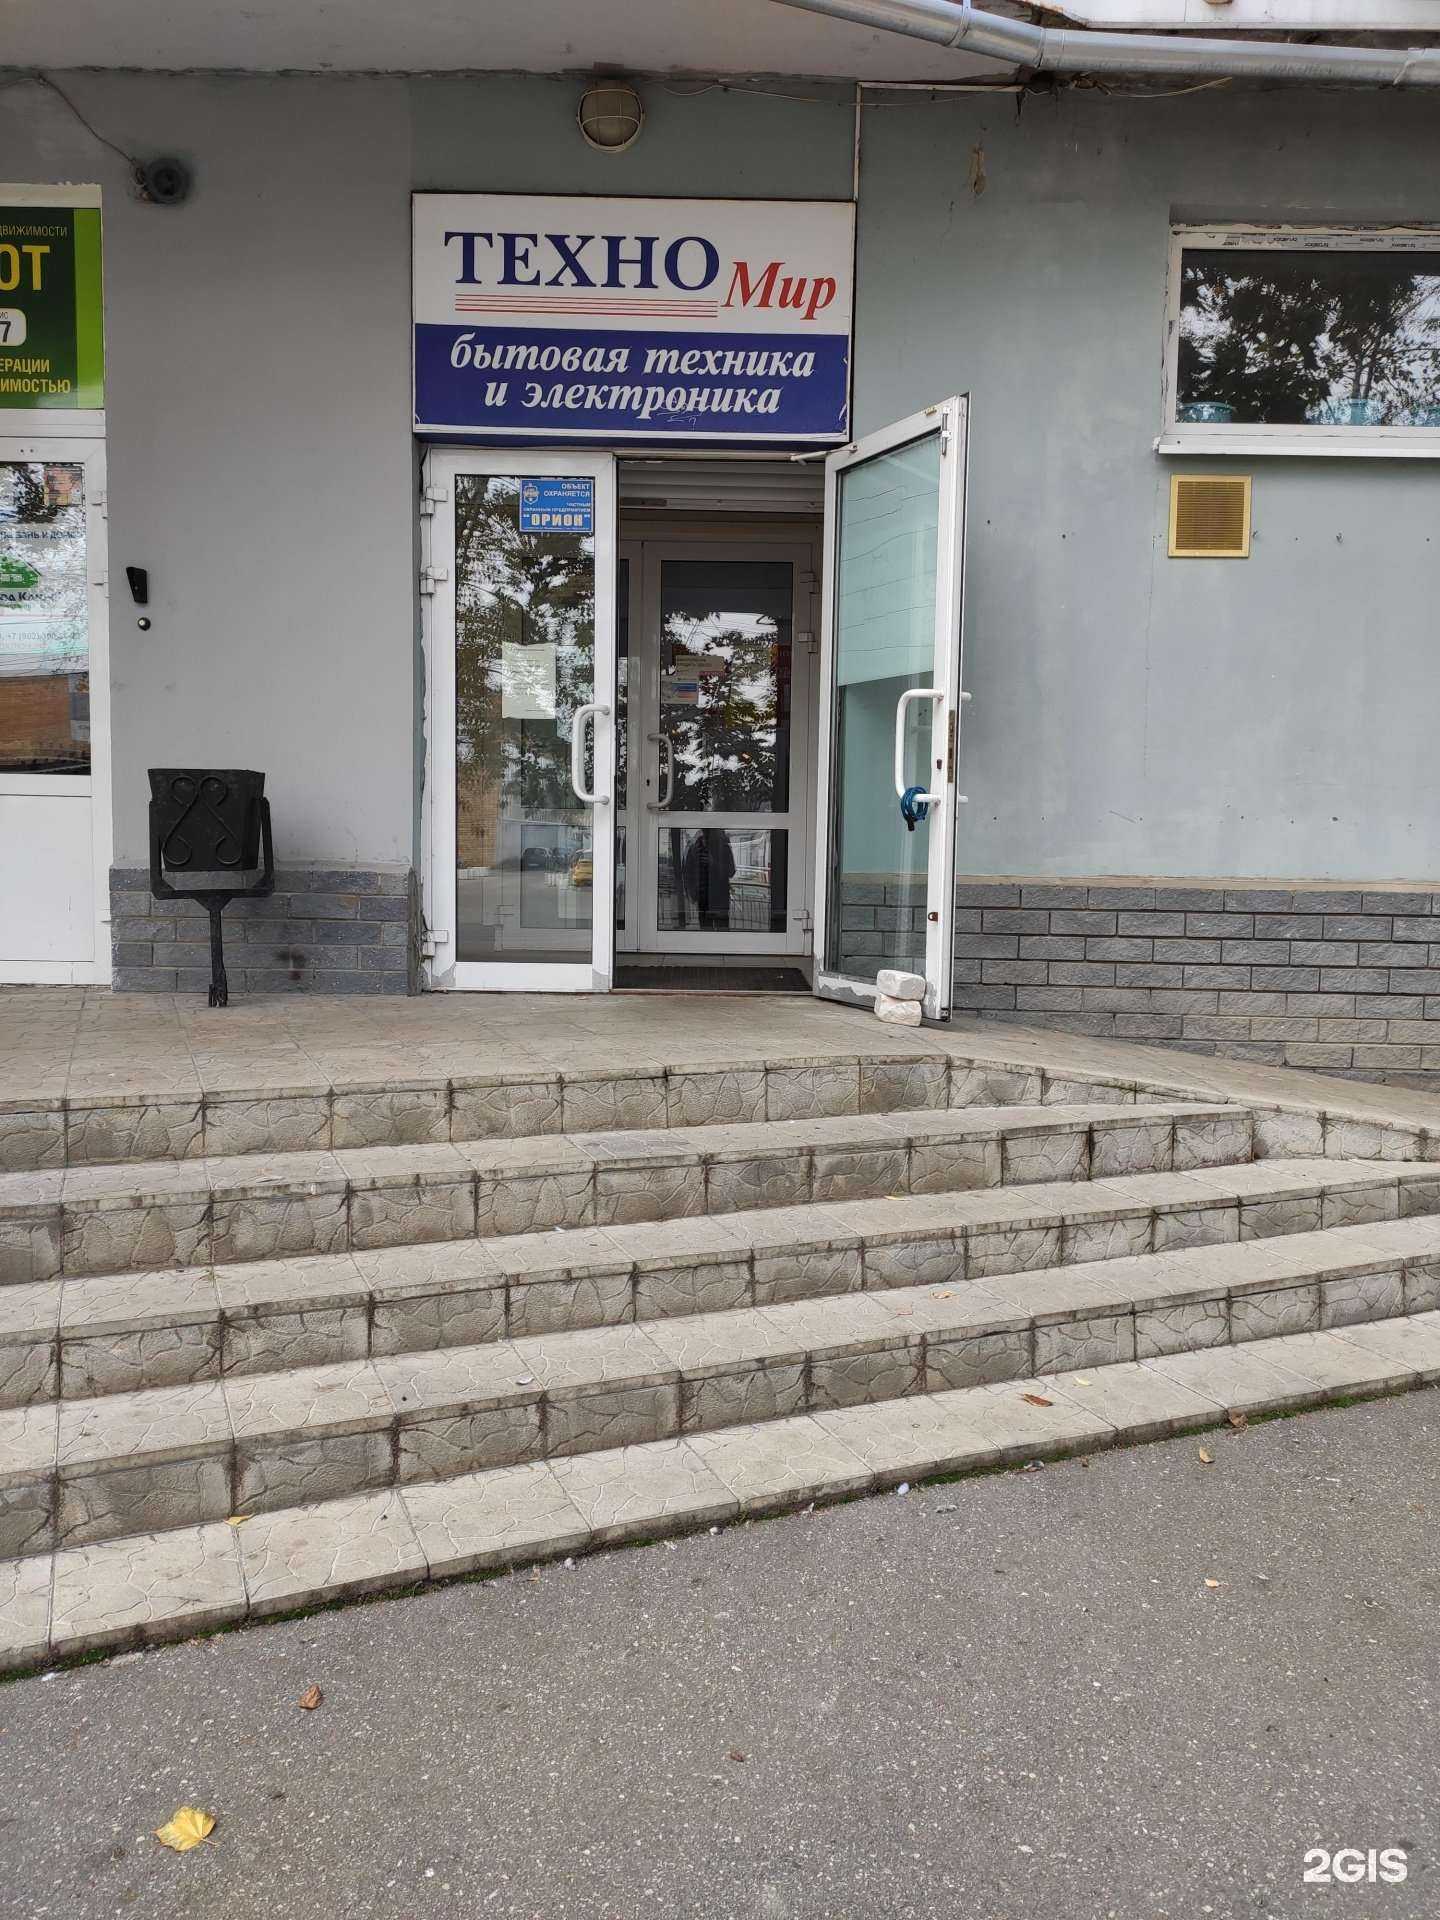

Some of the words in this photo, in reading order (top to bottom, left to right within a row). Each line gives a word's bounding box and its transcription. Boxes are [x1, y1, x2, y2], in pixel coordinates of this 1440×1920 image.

[444, 231, 720, 291] ТЕХНО
[721, 261, 837, 320] Мир
[450, 332, 628, 374] бытовая
[643, 346, 816, 377] техника
[484, 381, 508, 407] и
[520, 382, 784, 420] электроника
